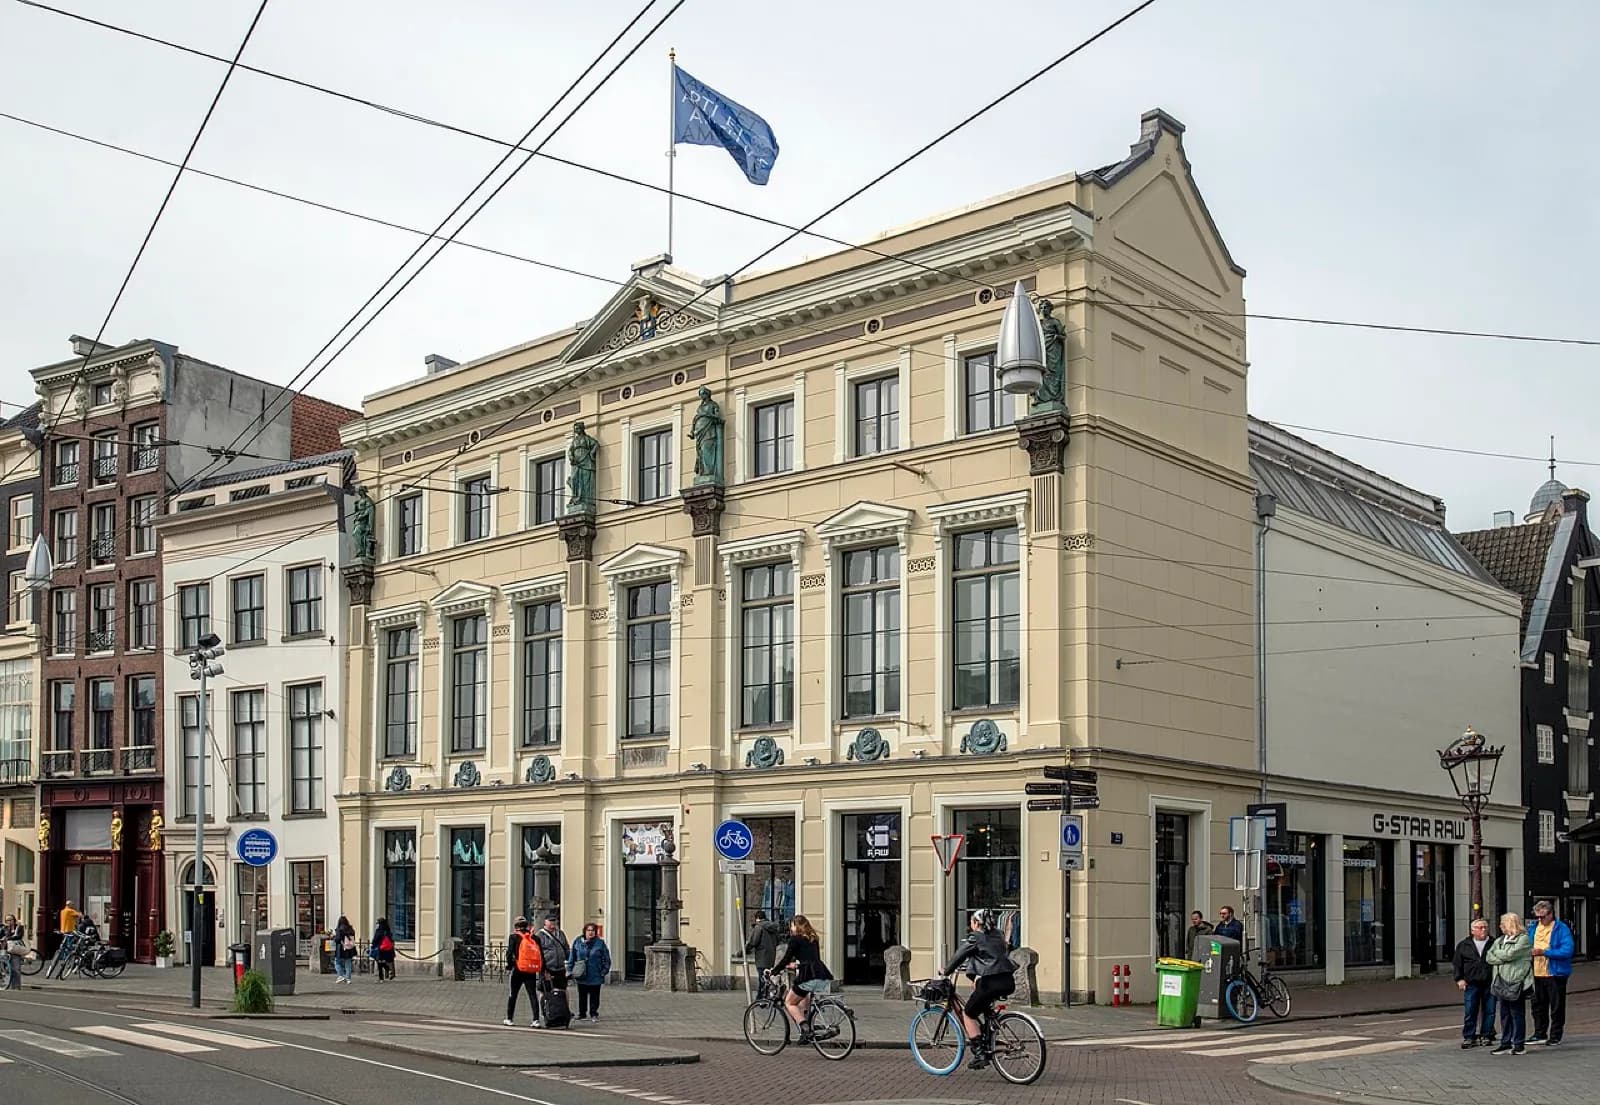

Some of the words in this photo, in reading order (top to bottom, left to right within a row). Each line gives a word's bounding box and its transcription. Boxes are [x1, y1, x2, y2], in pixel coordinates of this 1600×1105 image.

[1373, 813, 1430, 837] G-STAR
[1434, 819, 1465, 840] RAW
[867, 849, 889, 857] RAW
